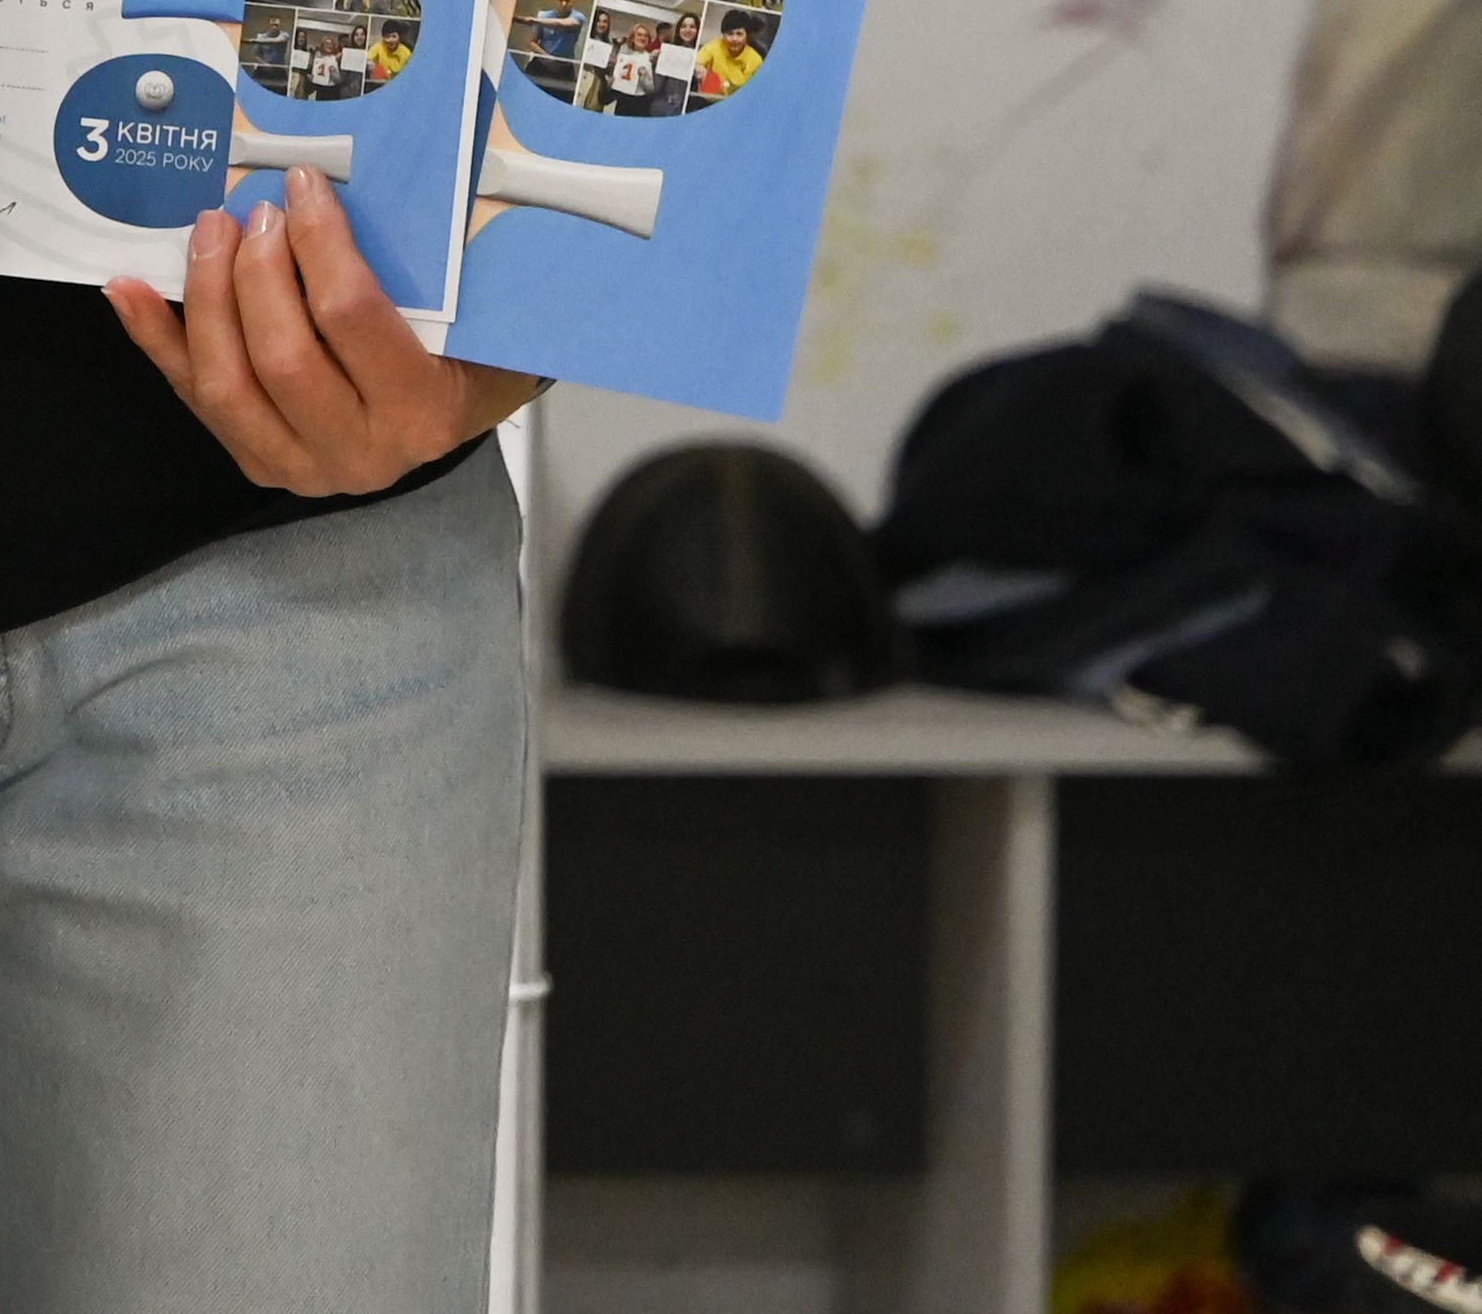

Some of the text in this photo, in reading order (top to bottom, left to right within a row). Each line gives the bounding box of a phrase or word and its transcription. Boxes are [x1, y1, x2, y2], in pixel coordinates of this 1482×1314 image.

[76, 117, 110, 162] 3
[117, 121, 217, 152] КВІТНЯ
[115, 149, 214, 172] 2025 РОКУ
